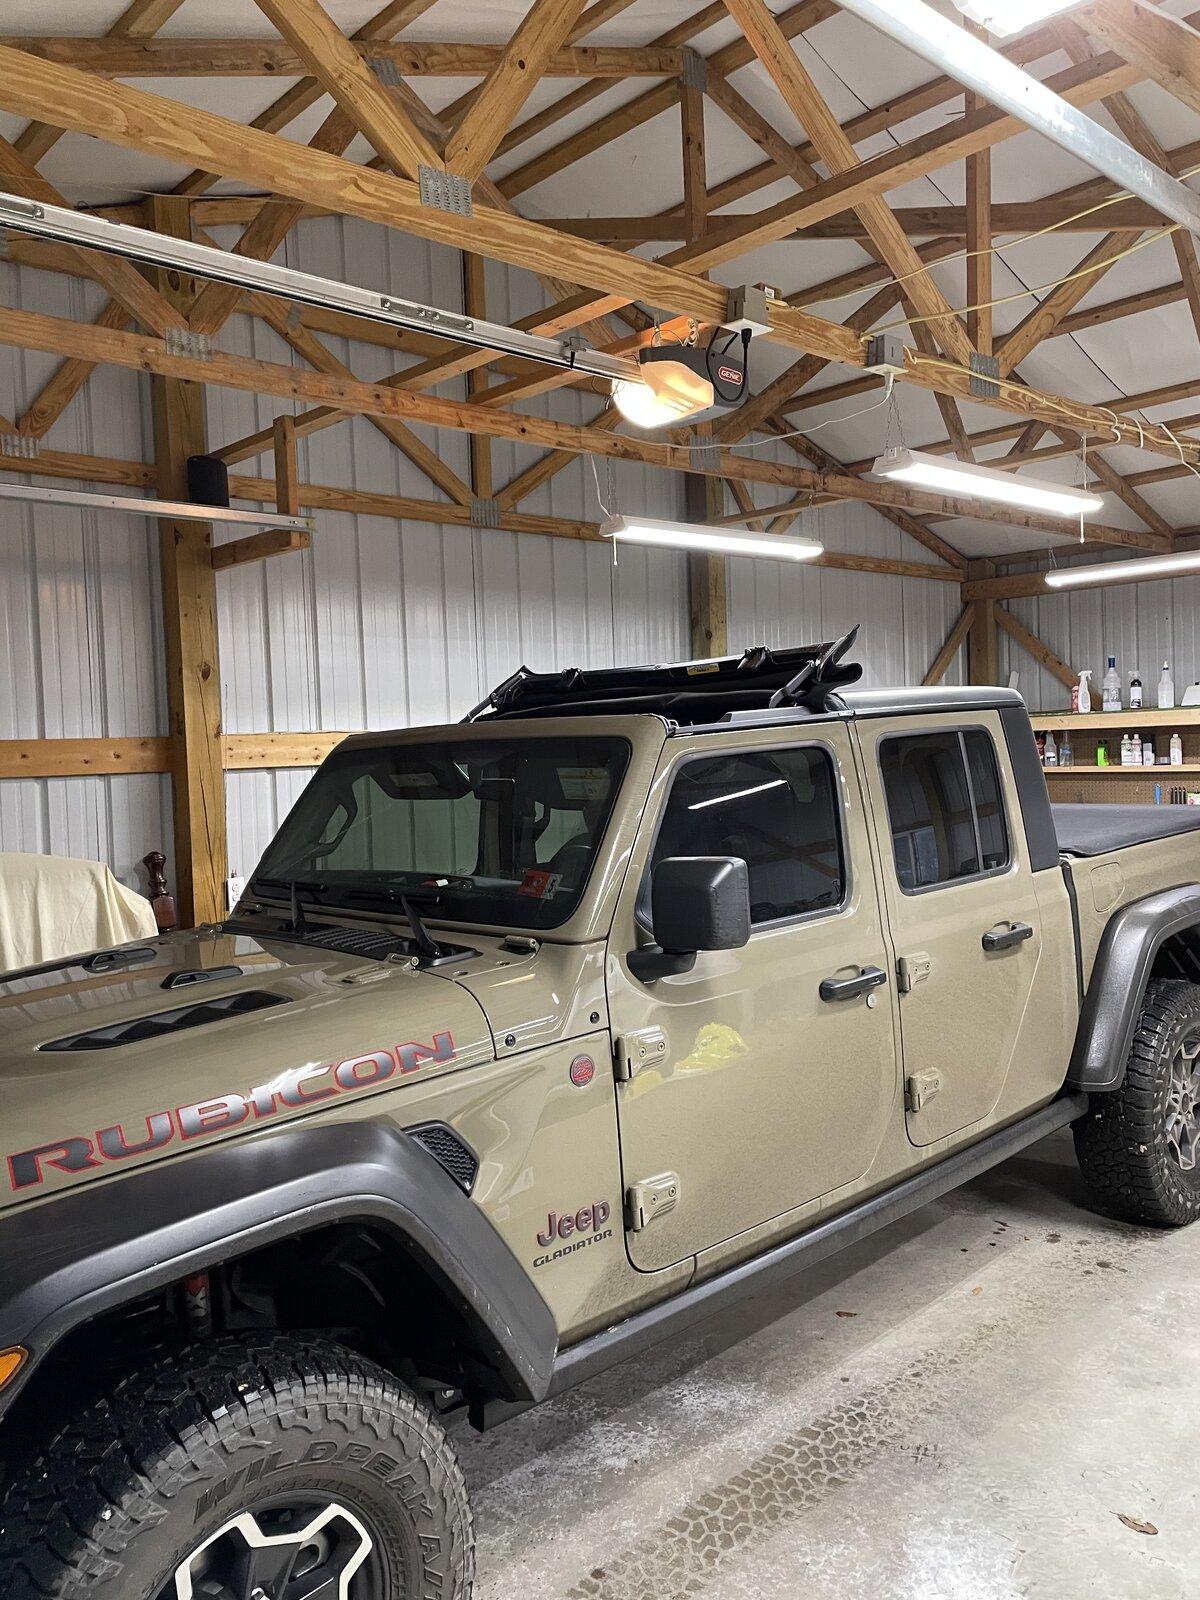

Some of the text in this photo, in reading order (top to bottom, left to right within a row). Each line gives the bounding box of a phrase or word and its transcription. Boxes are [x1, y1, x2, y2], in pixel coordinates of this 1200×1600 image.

[720, 369, 741, 382] GENIE
[7, 1031, 457, 1191] RUBICON
[537, 1200, 610, 1247] Jeep
[533, 1229, 613, 1268] GLADIATOR
[194, 1440, 434, 1527] WILDPEAK
